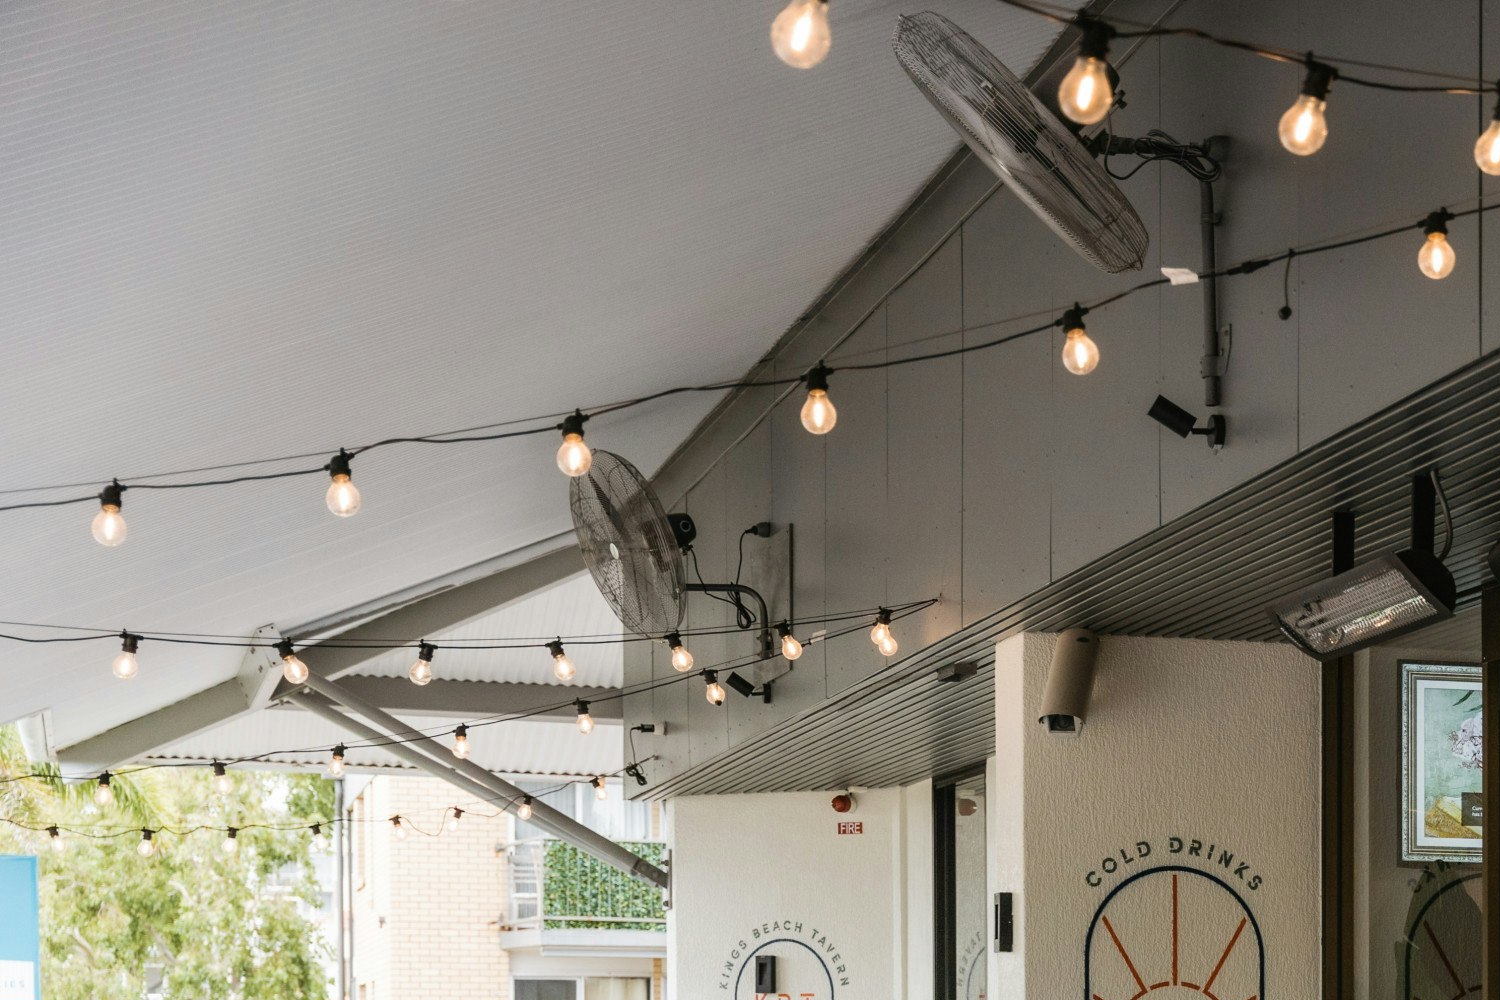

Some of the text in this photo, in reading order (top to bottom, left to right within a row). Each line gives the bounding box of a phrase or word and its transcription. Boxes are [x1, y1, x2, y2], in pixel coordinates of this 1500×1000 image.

[840, 822, 861, 834] FIRE
[1085, 836, 1263, 891] COLD DRINKS
[719, 920, 850, 990] KINGS BEACH TAVERN
